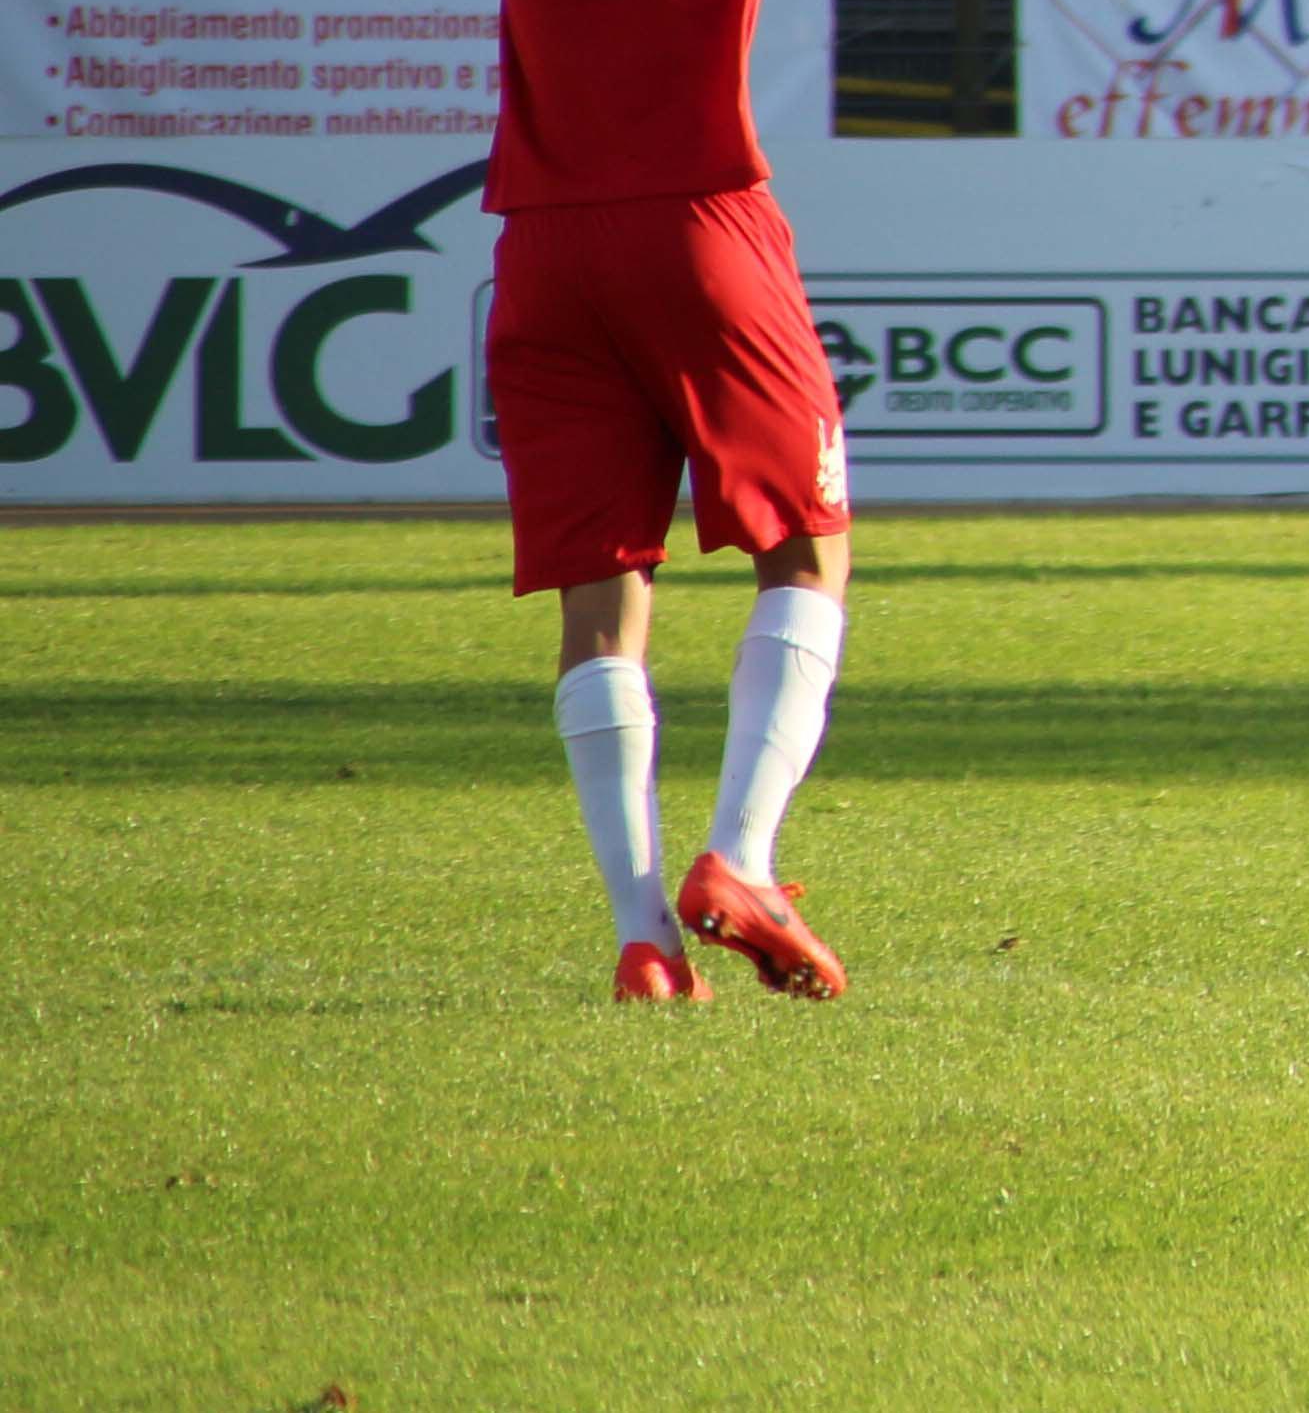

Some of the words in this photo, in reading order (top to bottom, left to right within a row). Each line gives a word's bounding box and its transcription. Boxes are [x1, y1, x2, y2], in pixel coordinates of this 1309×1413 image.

[66, 5, 301, 46] Abbigliamento
[66, 55, 301, 96] Abbigliamento
[312, 58, 445, 96] sportivo
[456, 64, 474, 89] e
[885, 325, 1074, 385] BCC
[1134, 400, 1162, 438] E
